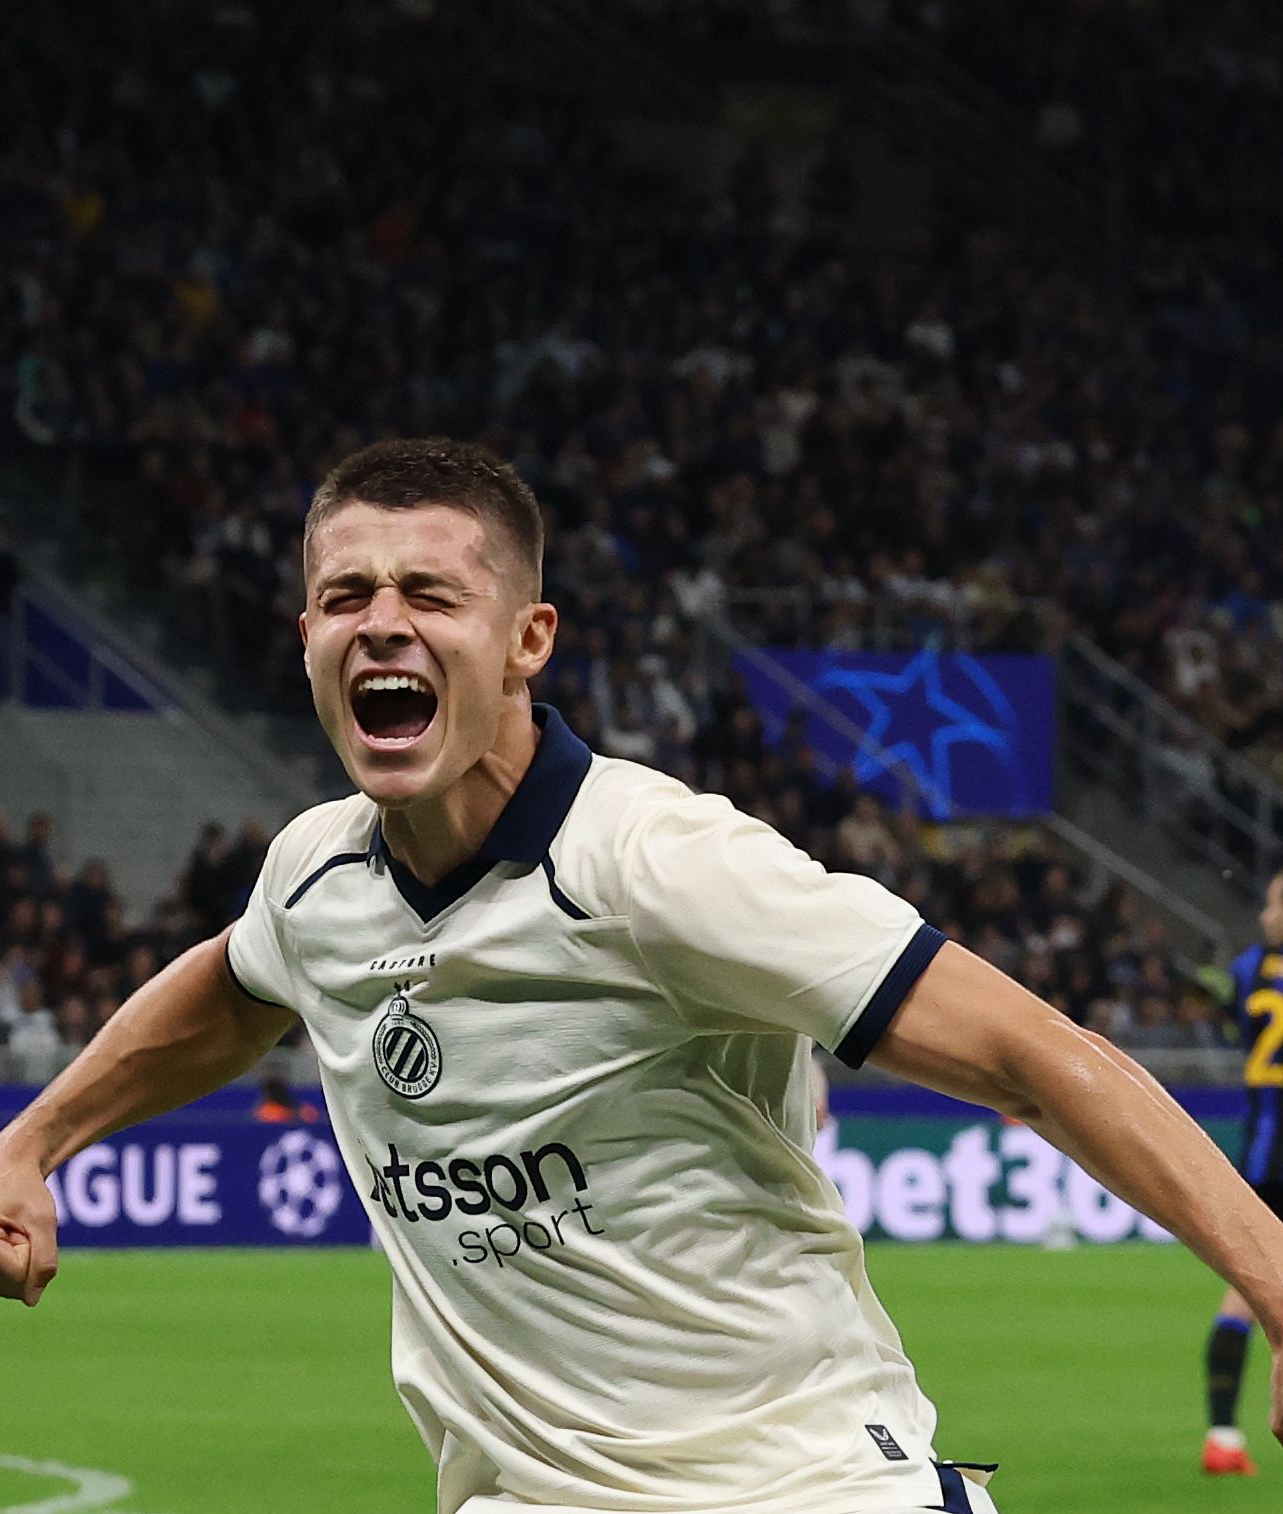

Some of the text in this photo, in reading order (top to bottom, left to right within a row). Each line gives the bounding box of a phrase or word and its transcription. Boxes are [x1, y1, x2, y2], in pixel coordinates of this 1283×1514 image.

[370, 953, 436, 970] CASTORE
[364, 1142, 588, 1222] tsson
[812, 1115, 1177, 1243] bet36
[452, 1196, 606, 1268] .sport
